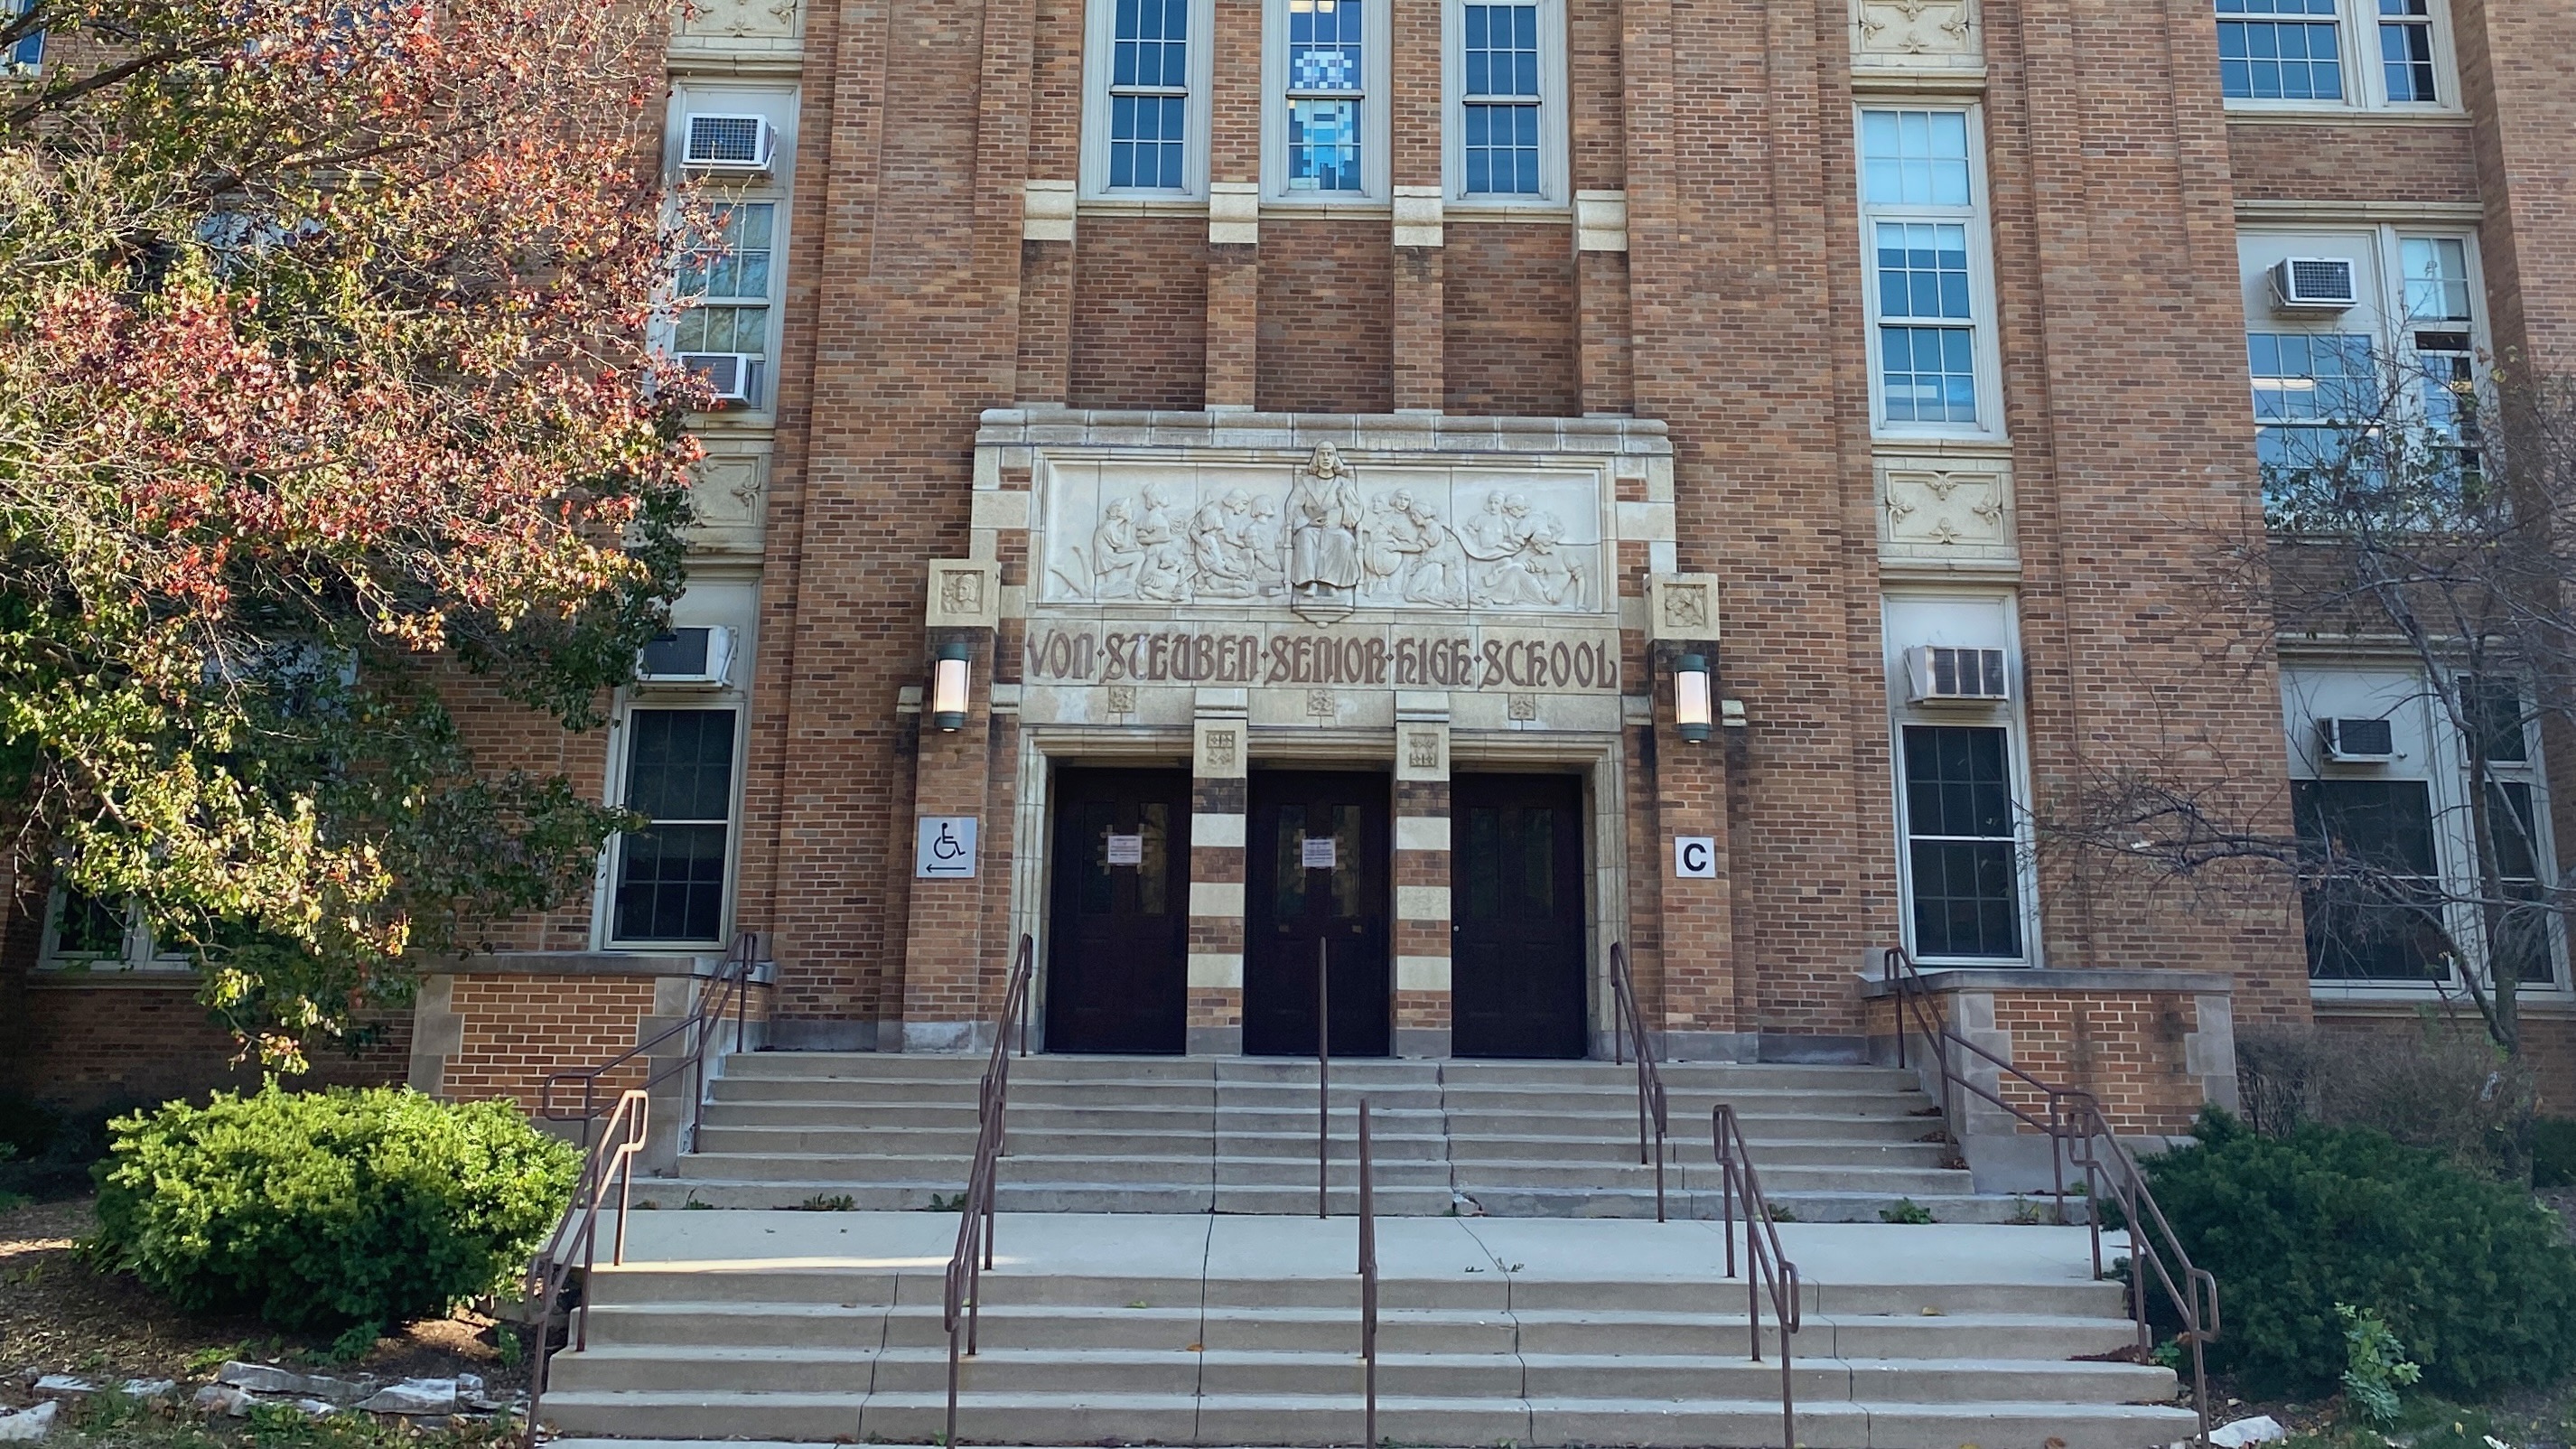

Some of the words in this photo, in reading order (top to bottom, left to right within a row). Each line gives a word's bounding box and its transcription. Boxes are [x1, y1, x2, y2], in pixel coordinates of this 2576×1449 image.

[1026, 628, 1096, 679] VON
[1102, 632, 1260, 683] STEUBEN
[1265, 635, 1386, 686] SENIOR
[1683, 843, 1707, 872] C
